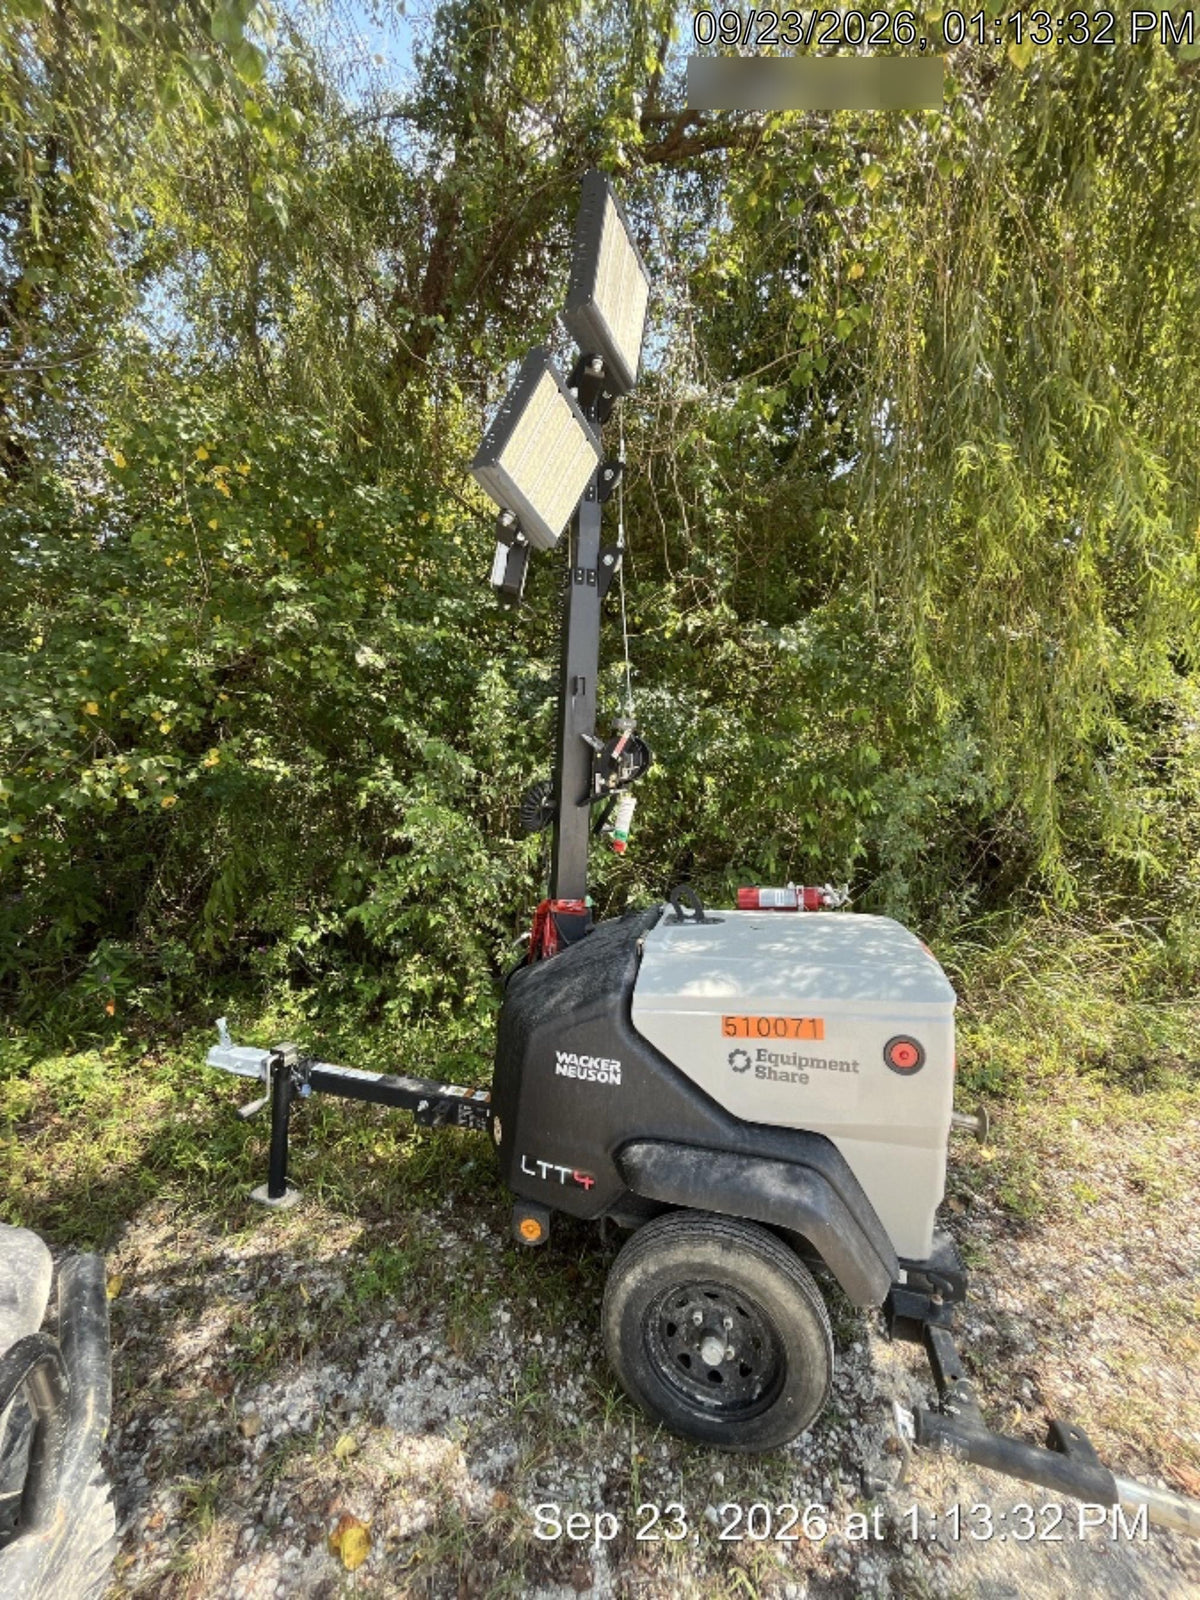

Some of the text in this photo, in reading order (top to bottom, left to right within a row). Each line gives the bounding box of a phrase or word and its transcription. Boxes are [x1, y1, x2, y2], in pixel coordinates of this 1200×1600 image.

[724, 1016, 818, 1039] 510071
[555, 1050, 621, 1073] WACKER
[755, 1049, 860, 1074] Equipment
[555, 1062, 622, 1085] NEUSON
[755, 1064, 810, 1085] Share
[521, 1154, 595, 1190] LTT4
